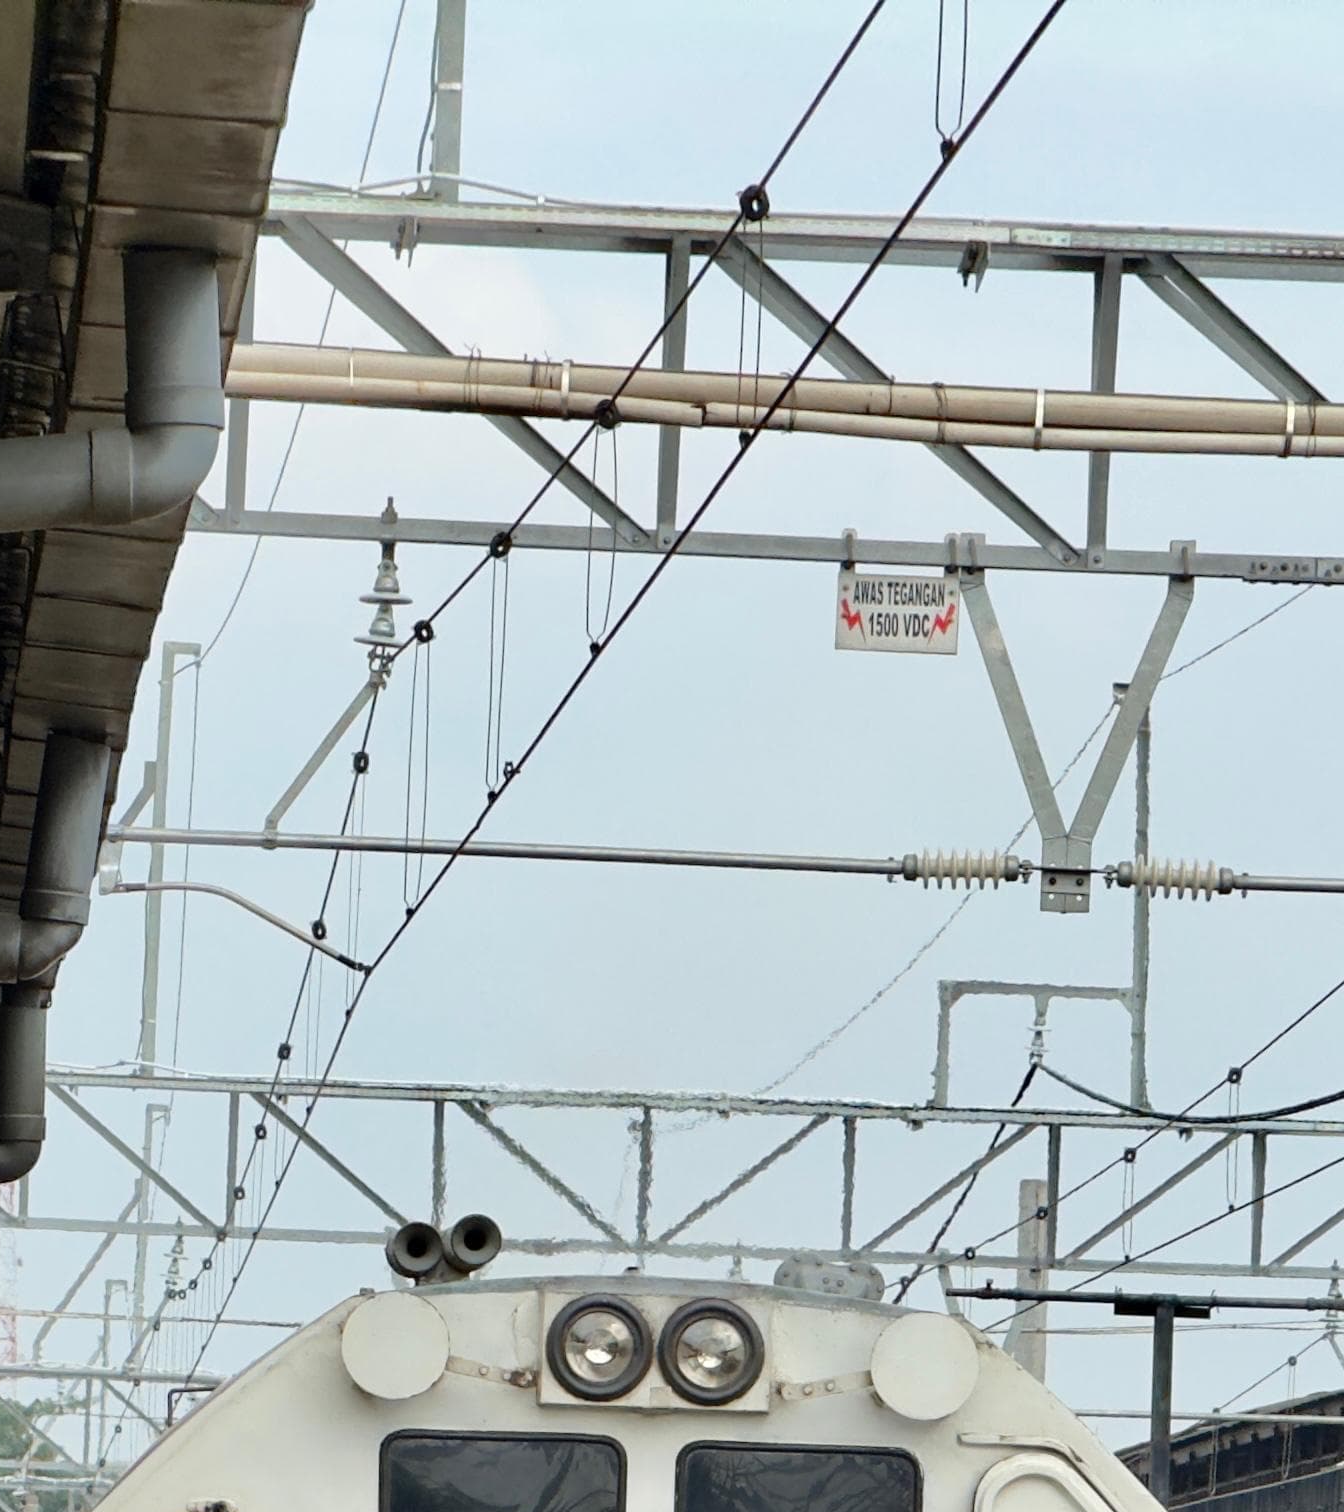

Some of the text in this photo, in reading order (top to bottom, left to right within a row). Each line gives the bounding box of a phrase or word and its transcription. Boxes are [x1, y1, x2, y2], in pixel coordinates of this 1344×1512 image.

[853, 581, 945, 607] AWAS TEGANGAN
[869, 612, 930, 638] 1500 VDC
